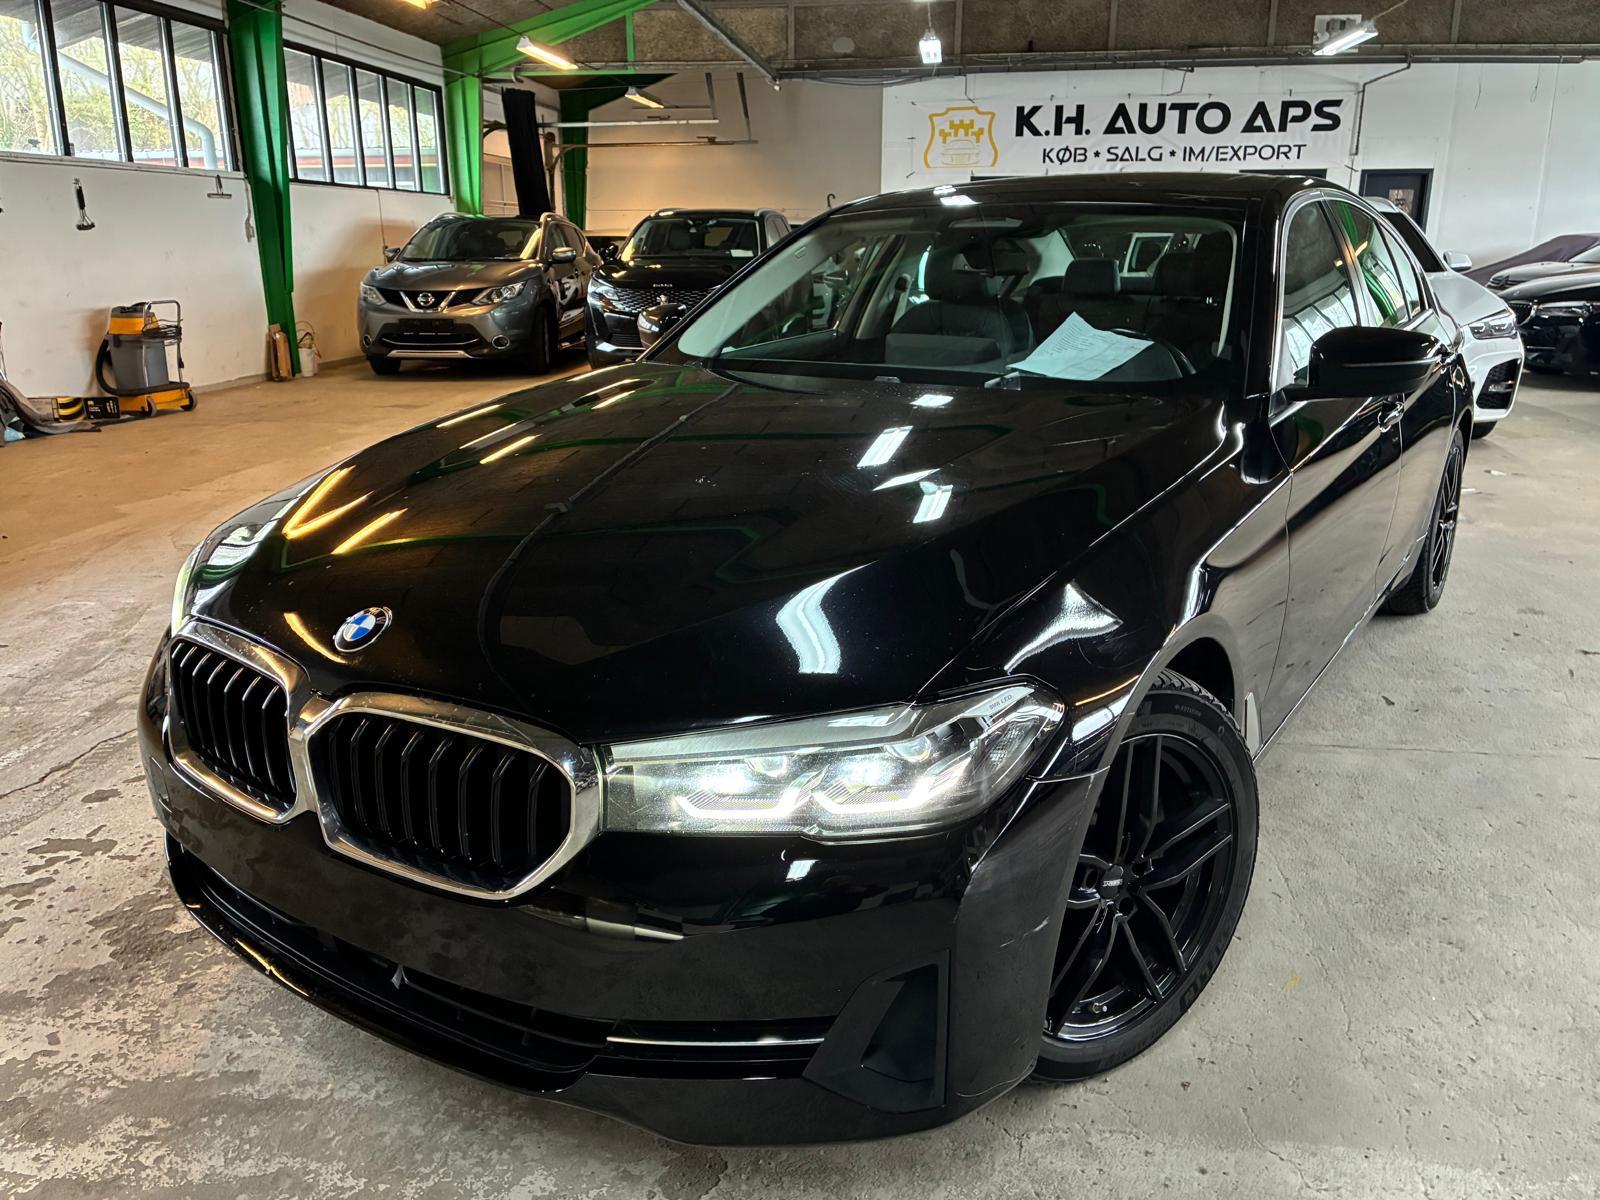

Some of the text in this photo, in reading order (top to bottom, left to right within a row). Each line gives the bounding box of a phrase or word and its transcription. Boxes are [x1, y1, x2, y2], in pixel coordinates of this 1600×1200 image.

[1014, 98, 1344, 138] K.H. AUTO APS
[1042, 144, 1307, 165] KØB SALG IM/EXPORT
